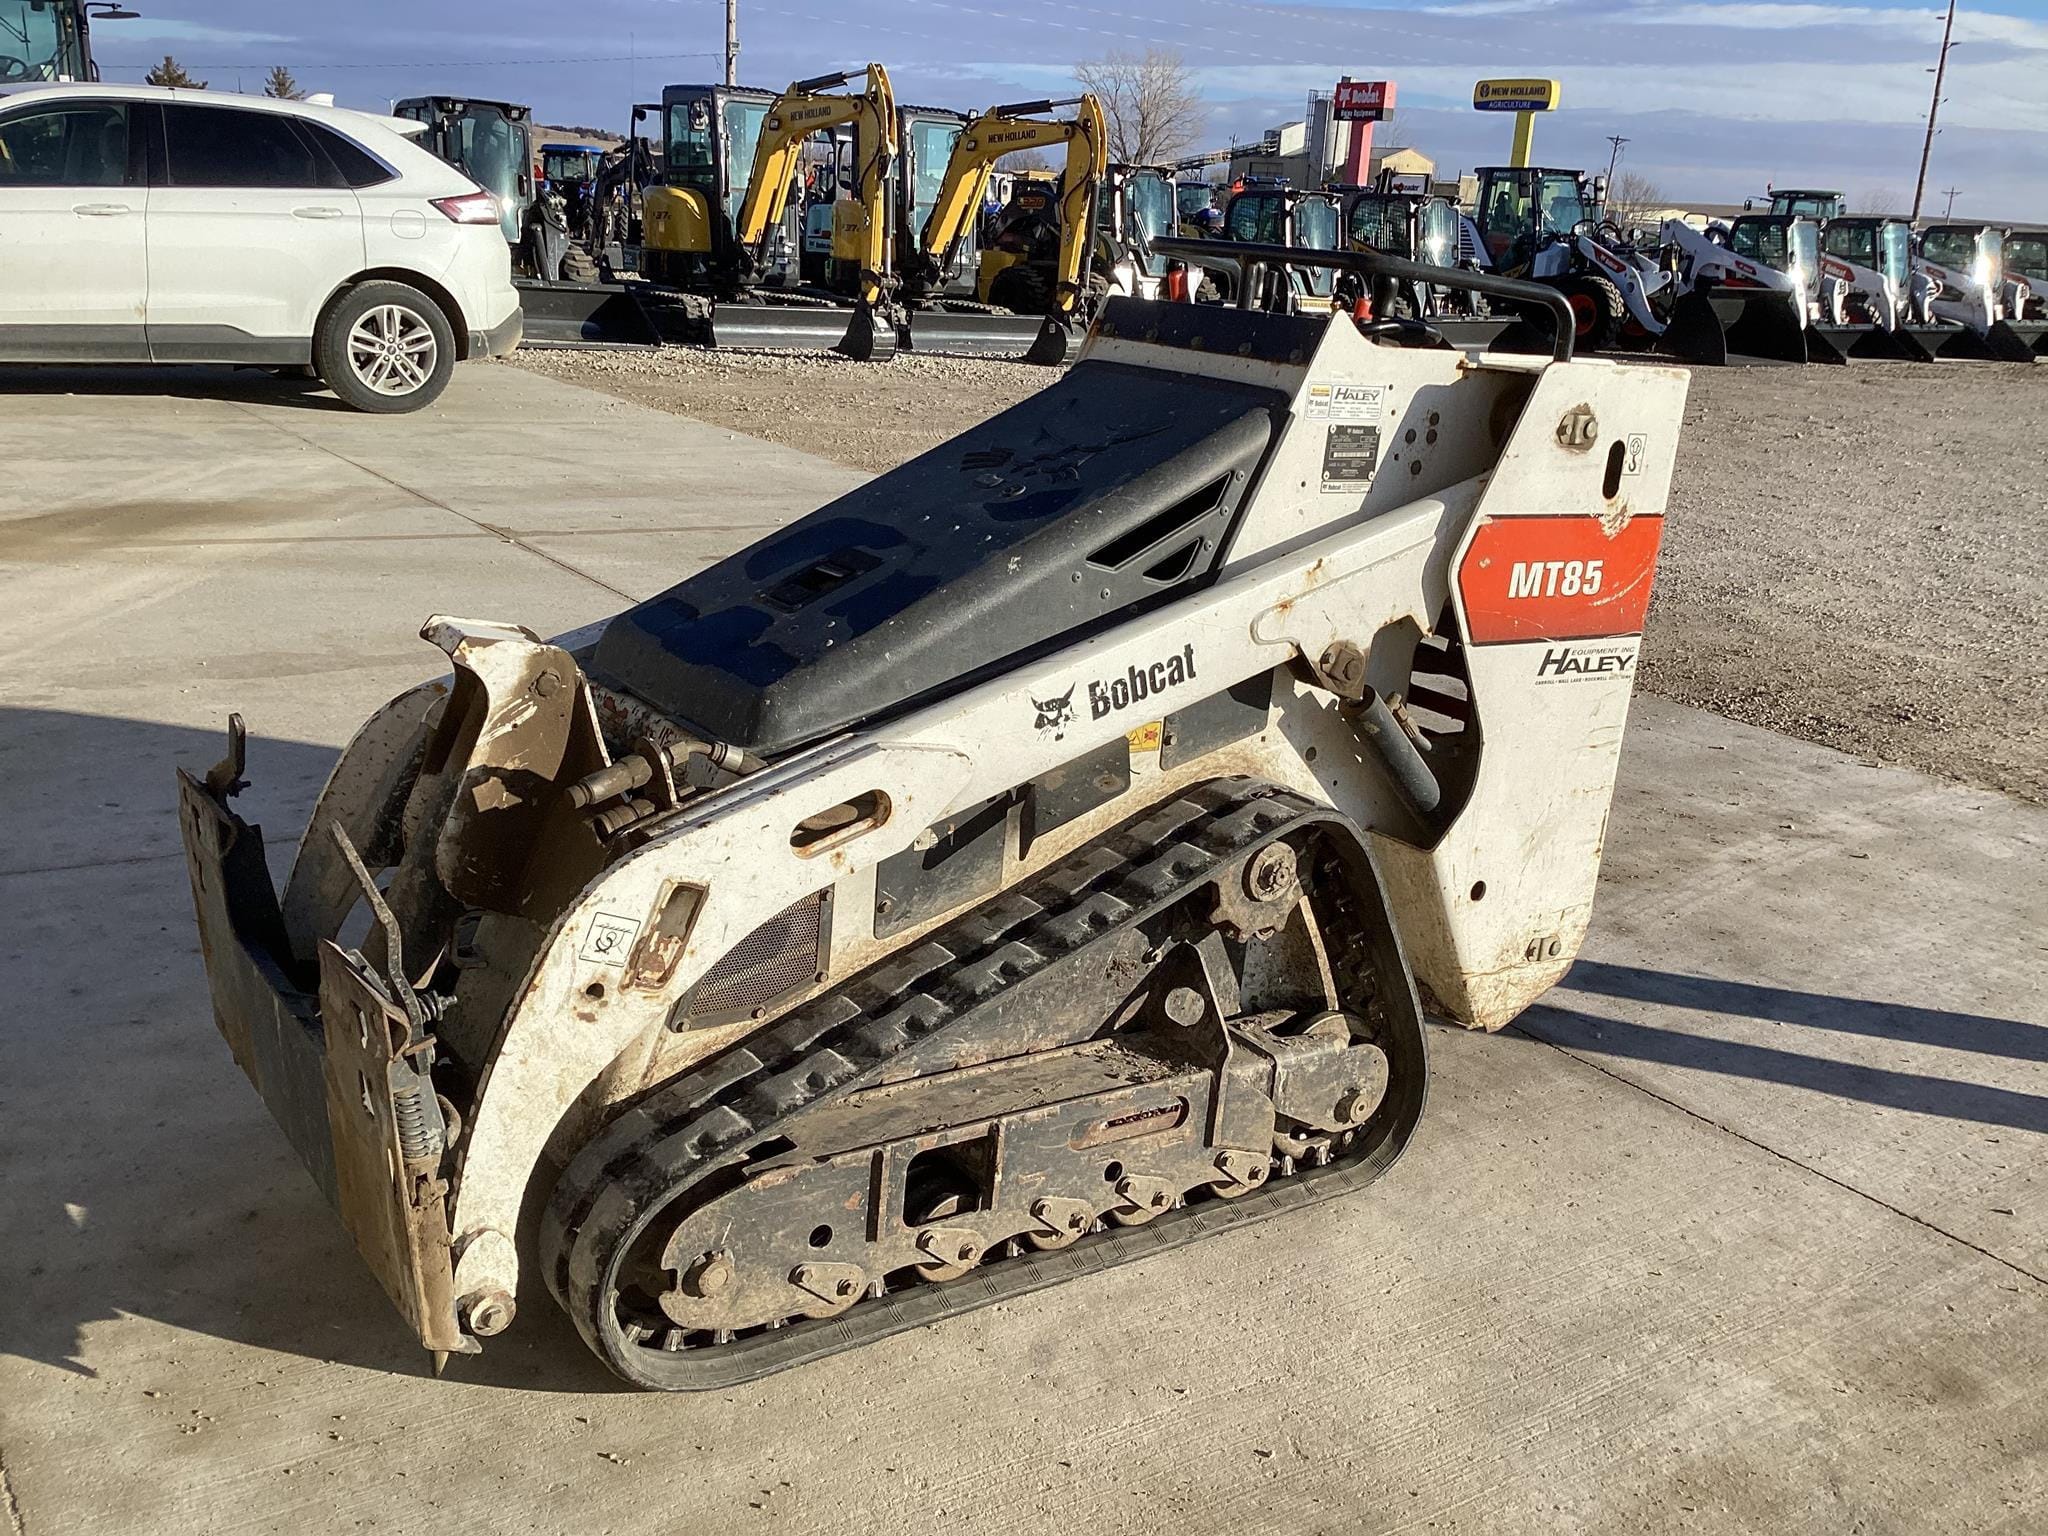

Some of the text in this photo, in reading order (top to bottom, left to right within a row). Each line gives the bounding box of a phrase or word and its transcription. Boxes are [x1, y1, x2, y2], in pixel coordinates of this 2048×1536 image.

[1491, 86, 1546, 96] NEW HOLLAND
[1488, 101, 1530, 109] AGRICULTURE
[790, 105, 831, 121] NEW HOLLAND
[988, 129, 1036, 143] NEW HOLLAND
[1335, 388, 1380, 401] HALEY
[1507, 559, 1604, 599] MT85
[1571, 647, 1618, 656] EQUIPMENT
[1537, 648, 1634, 677] HALEY
[1087, 643, 1196, 721] Bobcat
